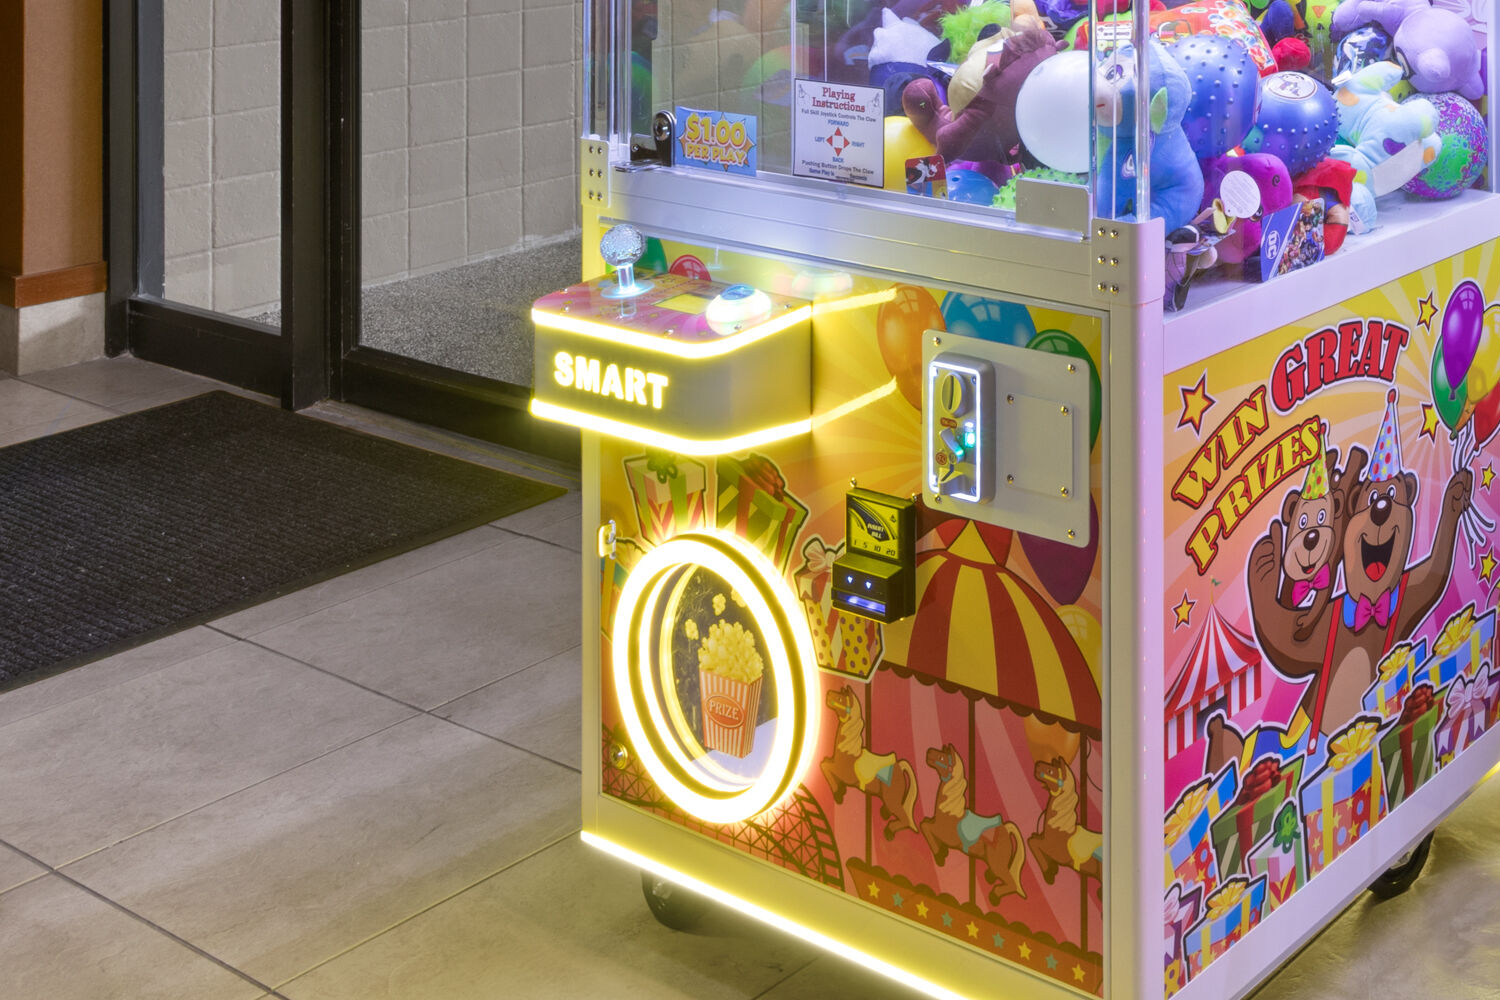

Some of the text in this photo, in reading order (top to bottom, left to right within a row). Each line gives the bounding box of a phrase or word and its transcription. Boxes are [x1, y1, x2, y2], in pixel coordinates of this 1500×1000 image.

[812, 97, 866, 112] Instructions
[822, 87, 855, 101] Playing
[685, 112, 746, 149] $1.00
[685, 142, 747, 166] PER PLAY
[802, 160, 820, 168] Pushing
[1267, 231, 1279, 260] DC
[553, 350, 669, 410] SMART
[1271, 320, 1410, 413] GREAT
[1171, 384, 1268, 509] WIN
[1185, 415, 1323, 576] PRIZES
[709, 700, 739, 721] PRIZE
